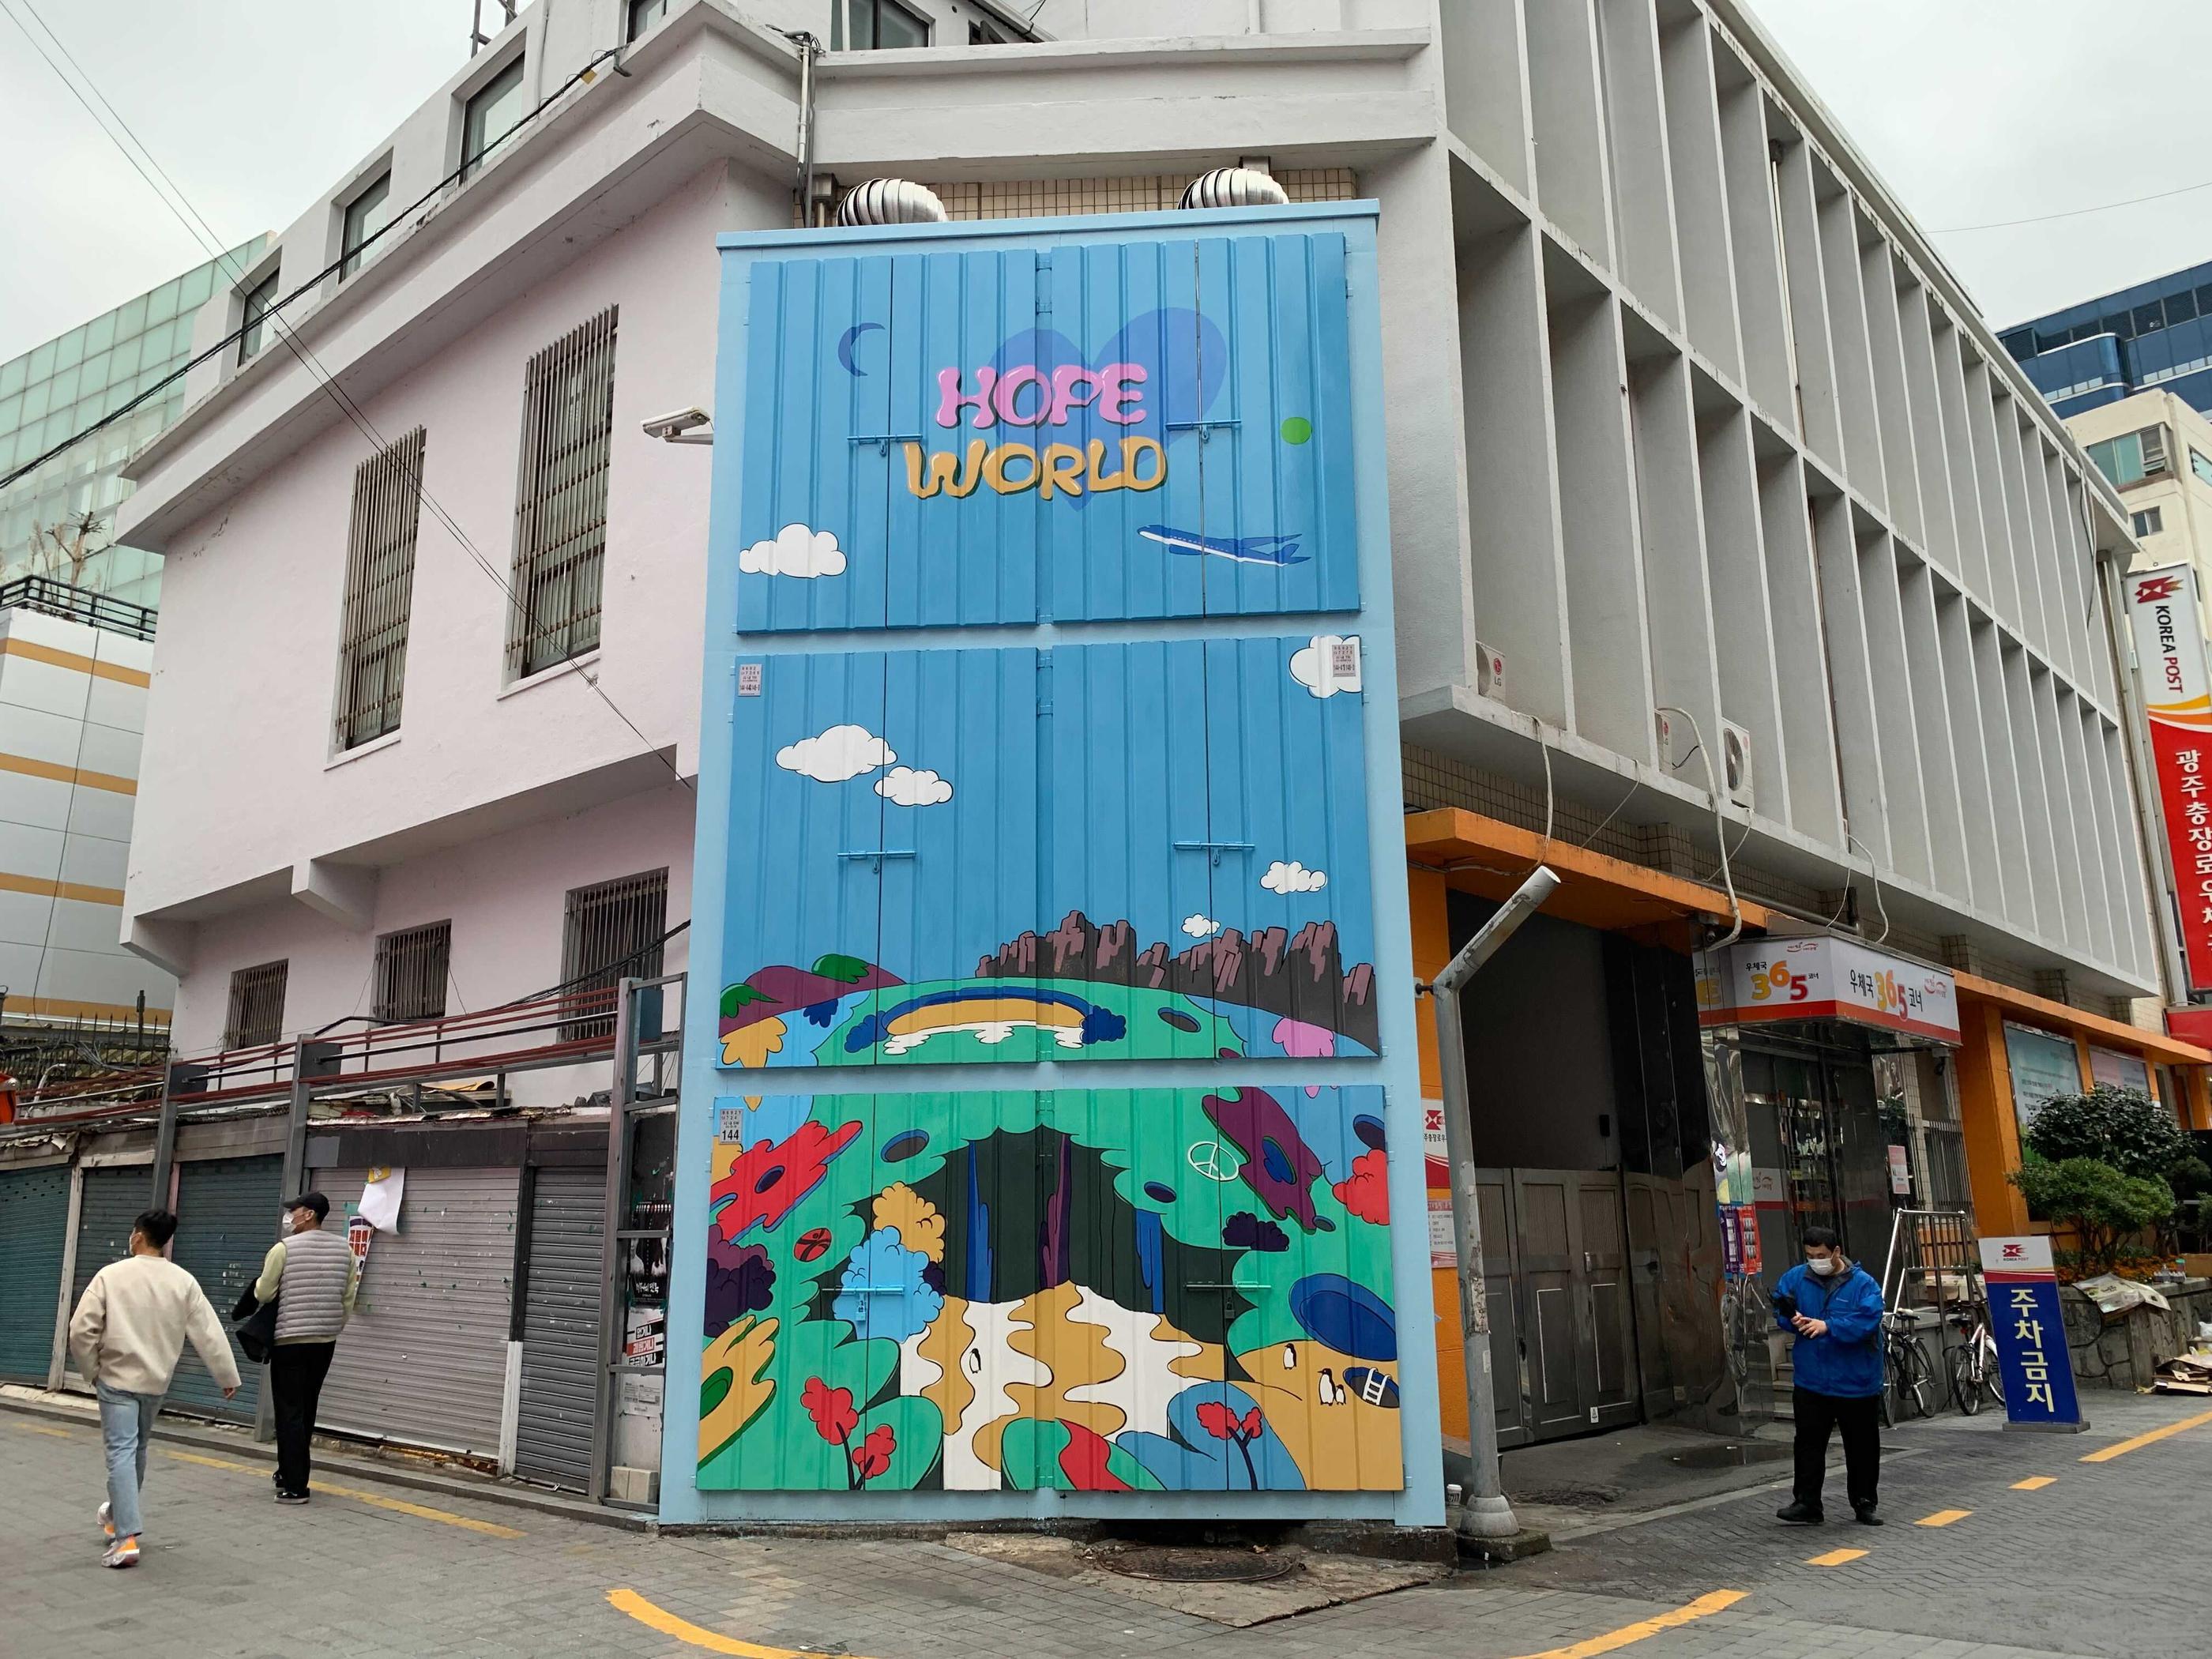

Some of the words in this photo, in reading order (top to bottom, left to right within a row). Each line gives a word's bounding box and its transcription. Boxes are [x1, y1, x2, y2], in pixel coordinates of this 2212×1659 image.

[935, 363, 1148, 429] HOPE
[904, 435, 1168, 501] WORLD
[2155, 605, 2176, 653] KOREA
[1494, 675, 1502, 687] LG
[2164, 656, 2183, 694] POST
[2175, 749, 2212, 953] 광주충장로우
[1746, 961, 1768, 972] 우체국
[1751, 960, 1809, 1001] 365
[1849, 969, 1875, 999] 우체국
[1874, 969, 1909, 1021] 365
[1908, 987, 1924, 1013] 코너
[722, 1129, 739, 1141] 144
[2011, 1288, 2055, 1413] 주차금지
